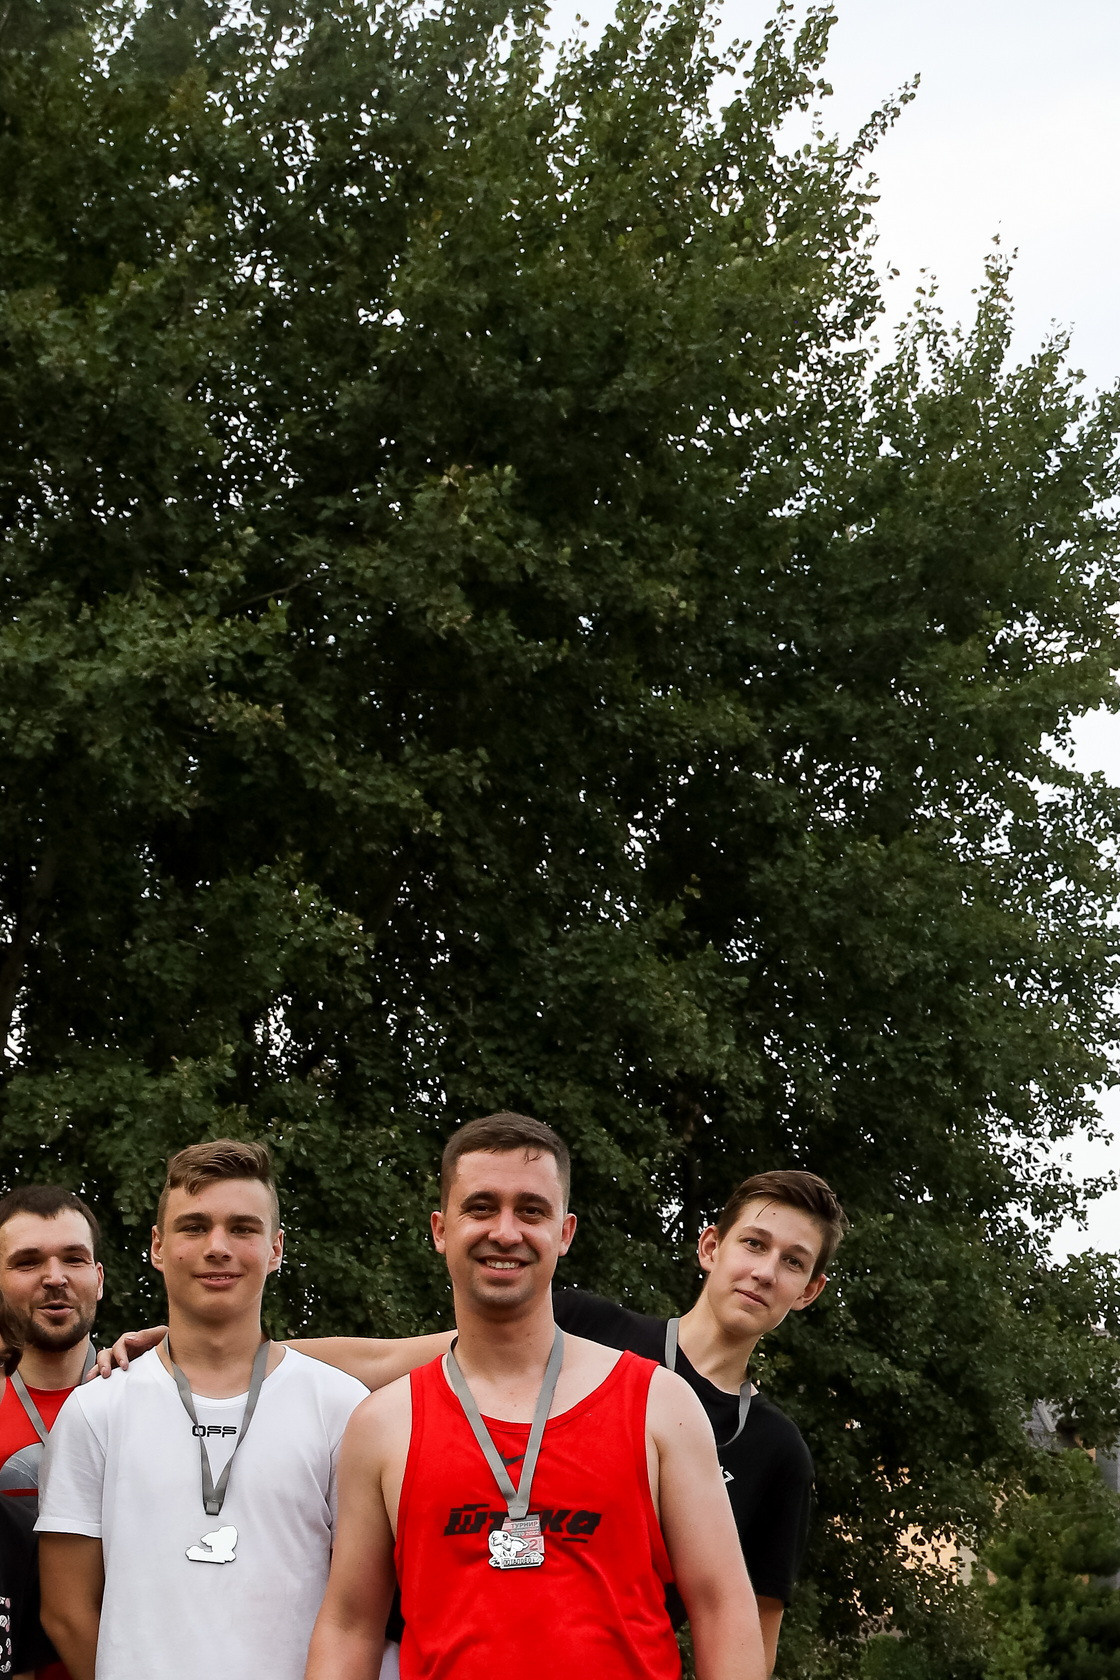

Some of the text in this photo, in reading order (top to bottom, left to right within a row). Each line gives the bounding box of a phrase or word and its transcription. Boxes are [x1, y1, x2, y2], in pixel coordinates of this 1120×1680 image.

[192, 1425, 237, 1438] OFF
[510, 1520, 539, 1529] ТУРНИР
[529, 1539, 538, 1551] 2
